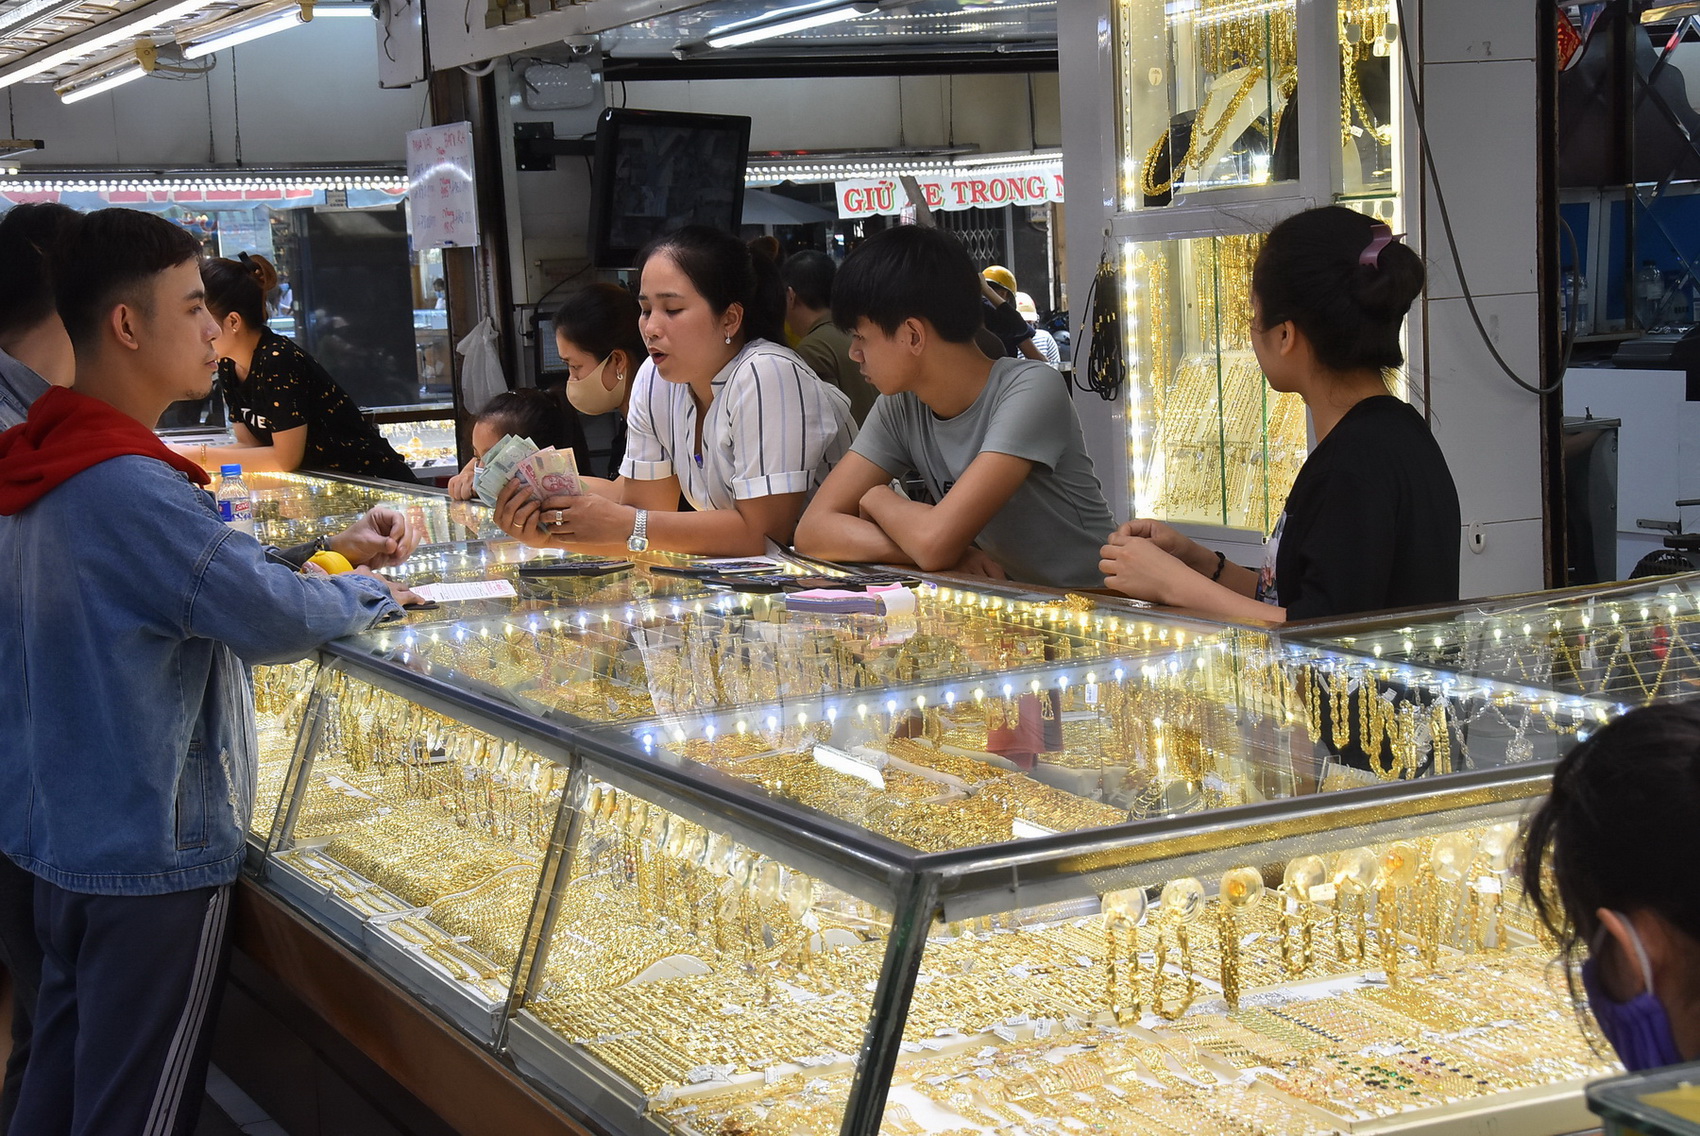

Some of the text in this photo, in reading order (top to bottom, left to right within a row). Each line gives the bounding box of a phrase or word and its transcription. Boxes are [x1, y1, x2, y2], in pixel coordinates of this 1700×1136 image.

[843, 180, 894, 213] GIỮ
[905, 182, 944, 207] E
[951, 175, 1046, 205] TRONG
